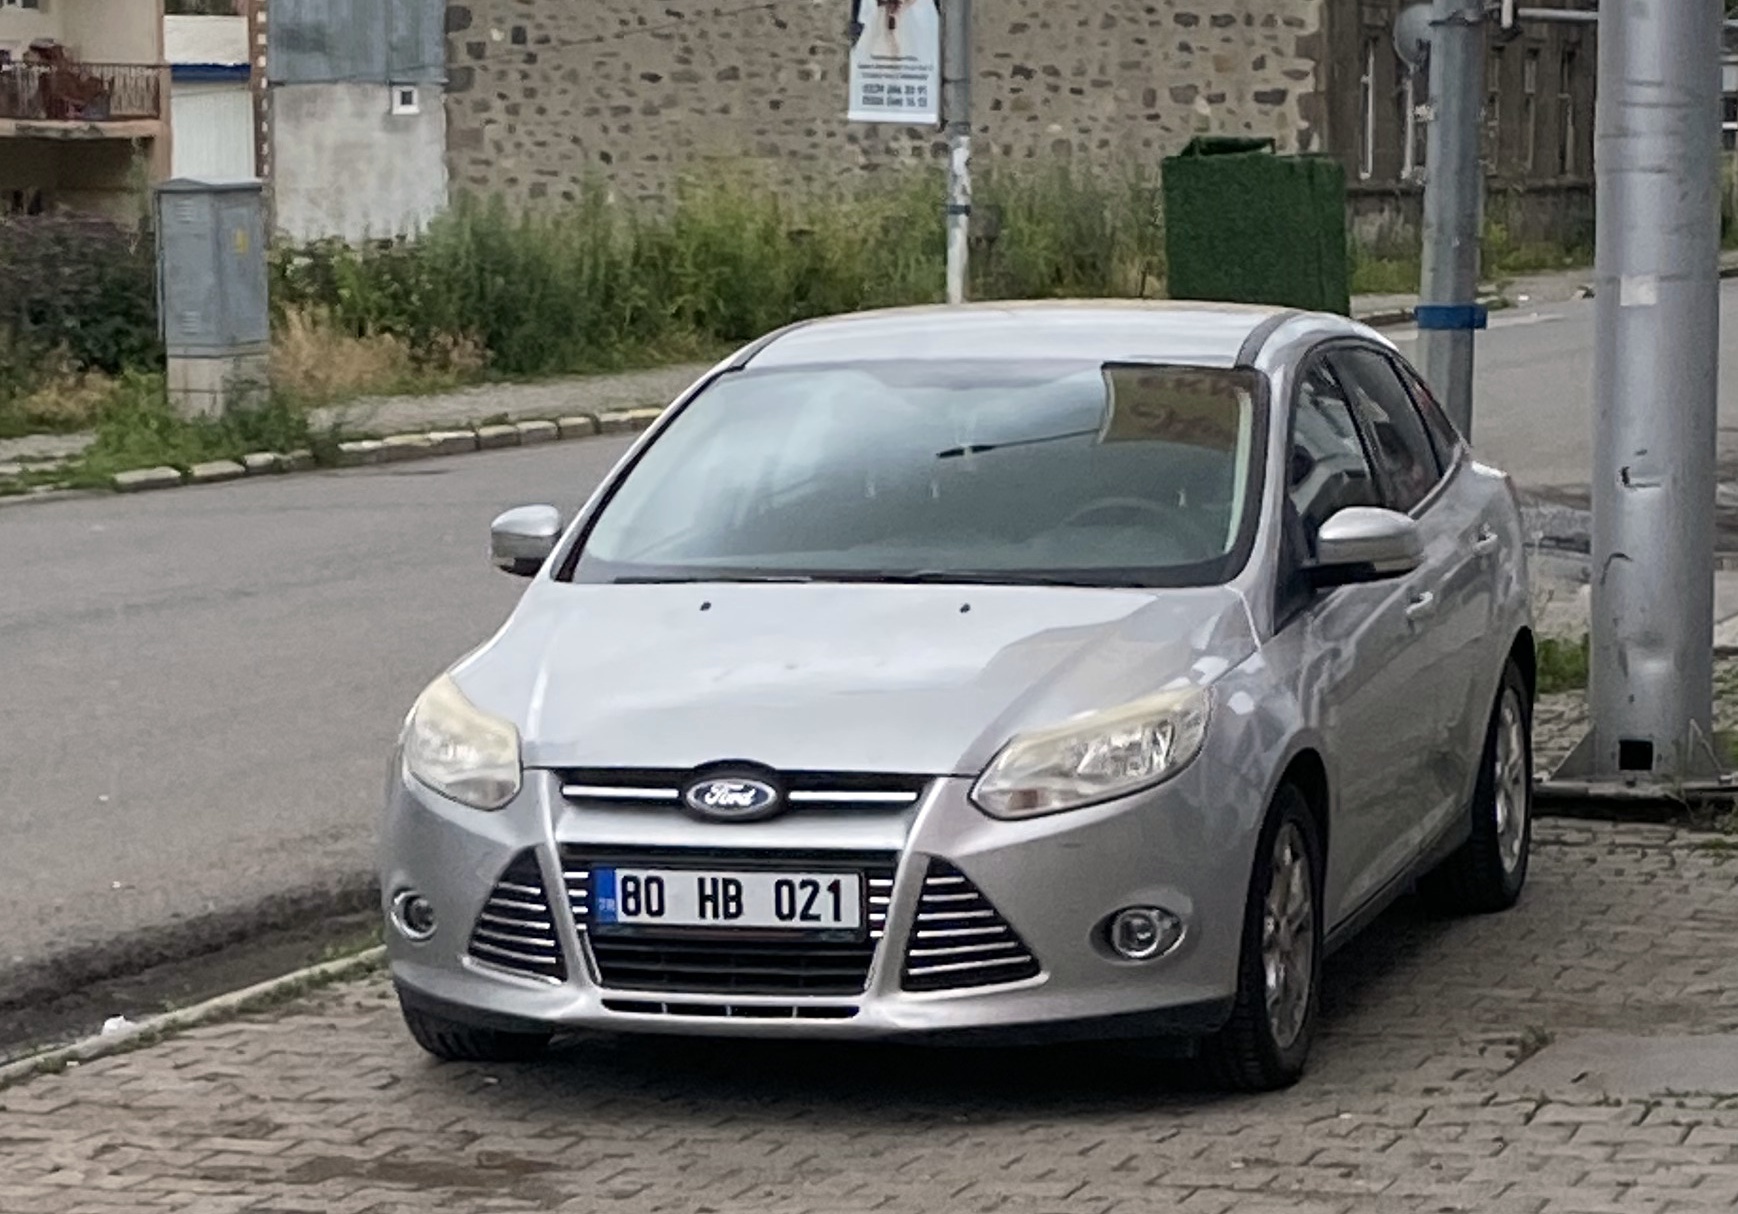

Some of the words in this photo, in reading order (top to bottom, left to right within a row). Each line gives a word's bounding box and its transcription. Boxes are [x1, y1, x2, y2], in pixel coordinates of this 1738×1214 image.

[704, 784, 756, 807] Ford
[621, 875, 665, 917] 80
[697, 876, 744, 920] HB
[774, 879, 842, 922] 021
